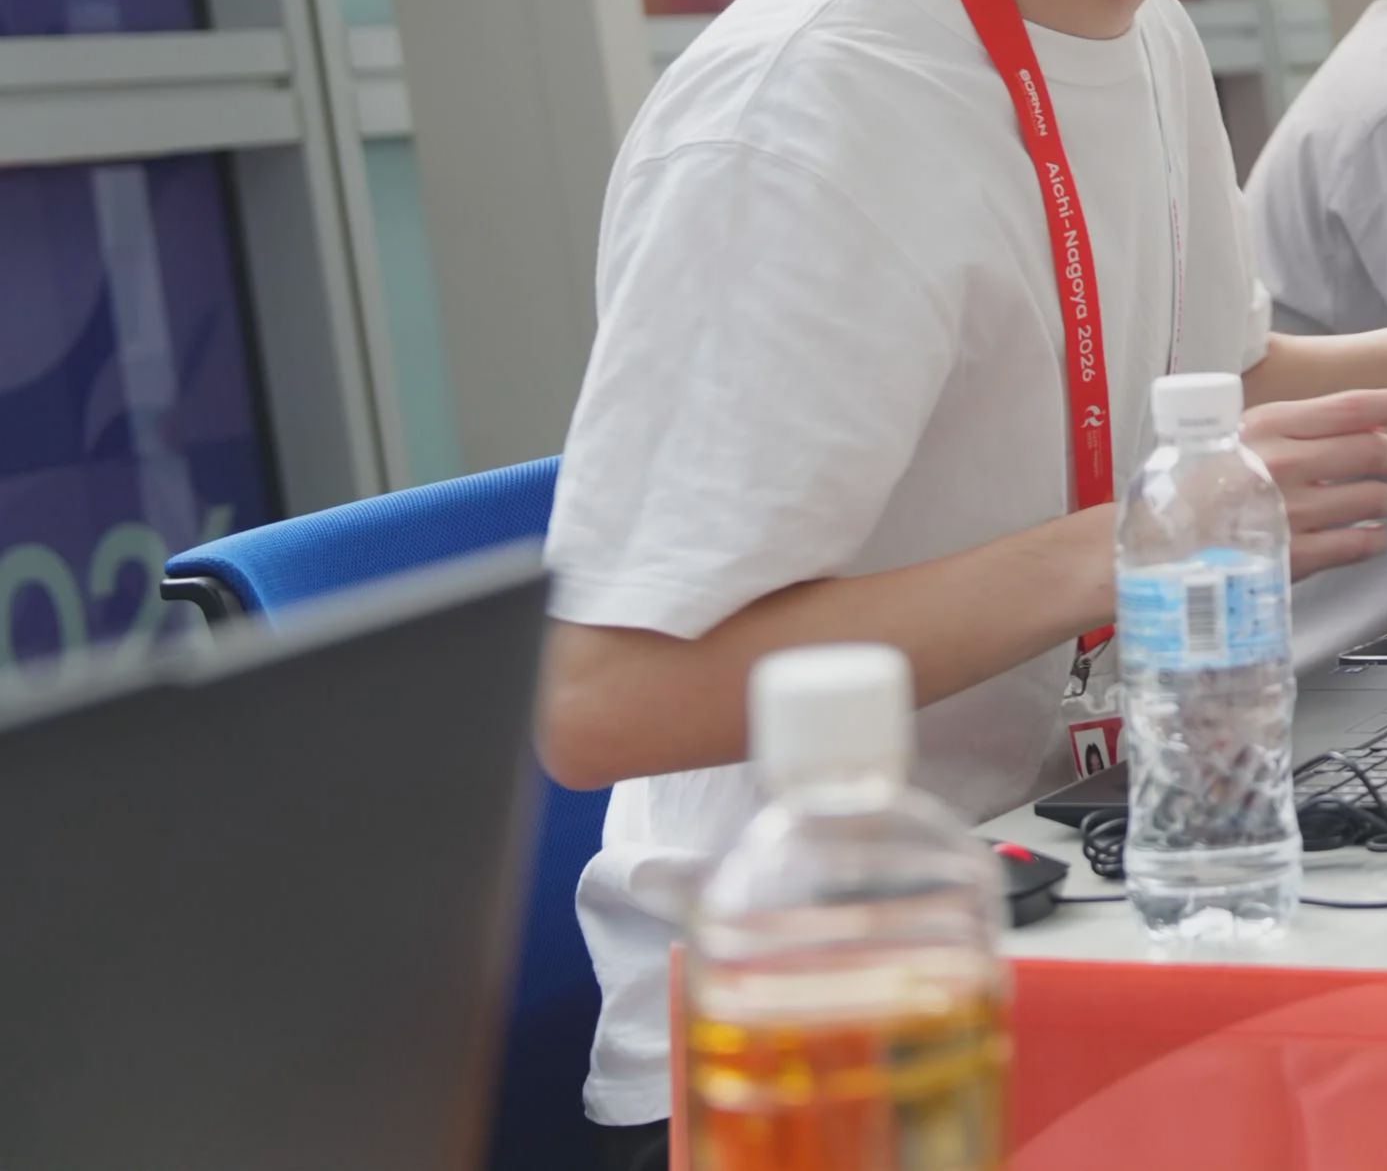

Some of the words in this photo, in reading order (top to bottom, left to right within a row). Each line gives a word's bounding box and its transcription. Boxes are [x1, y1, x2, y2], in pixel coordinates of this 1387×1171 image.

[1018, 68, 1048, 137] BORNAN
[1045, 161, 1089, 320] Aichi-Nagoya
[1078, 324, 1097, 383] 2026
